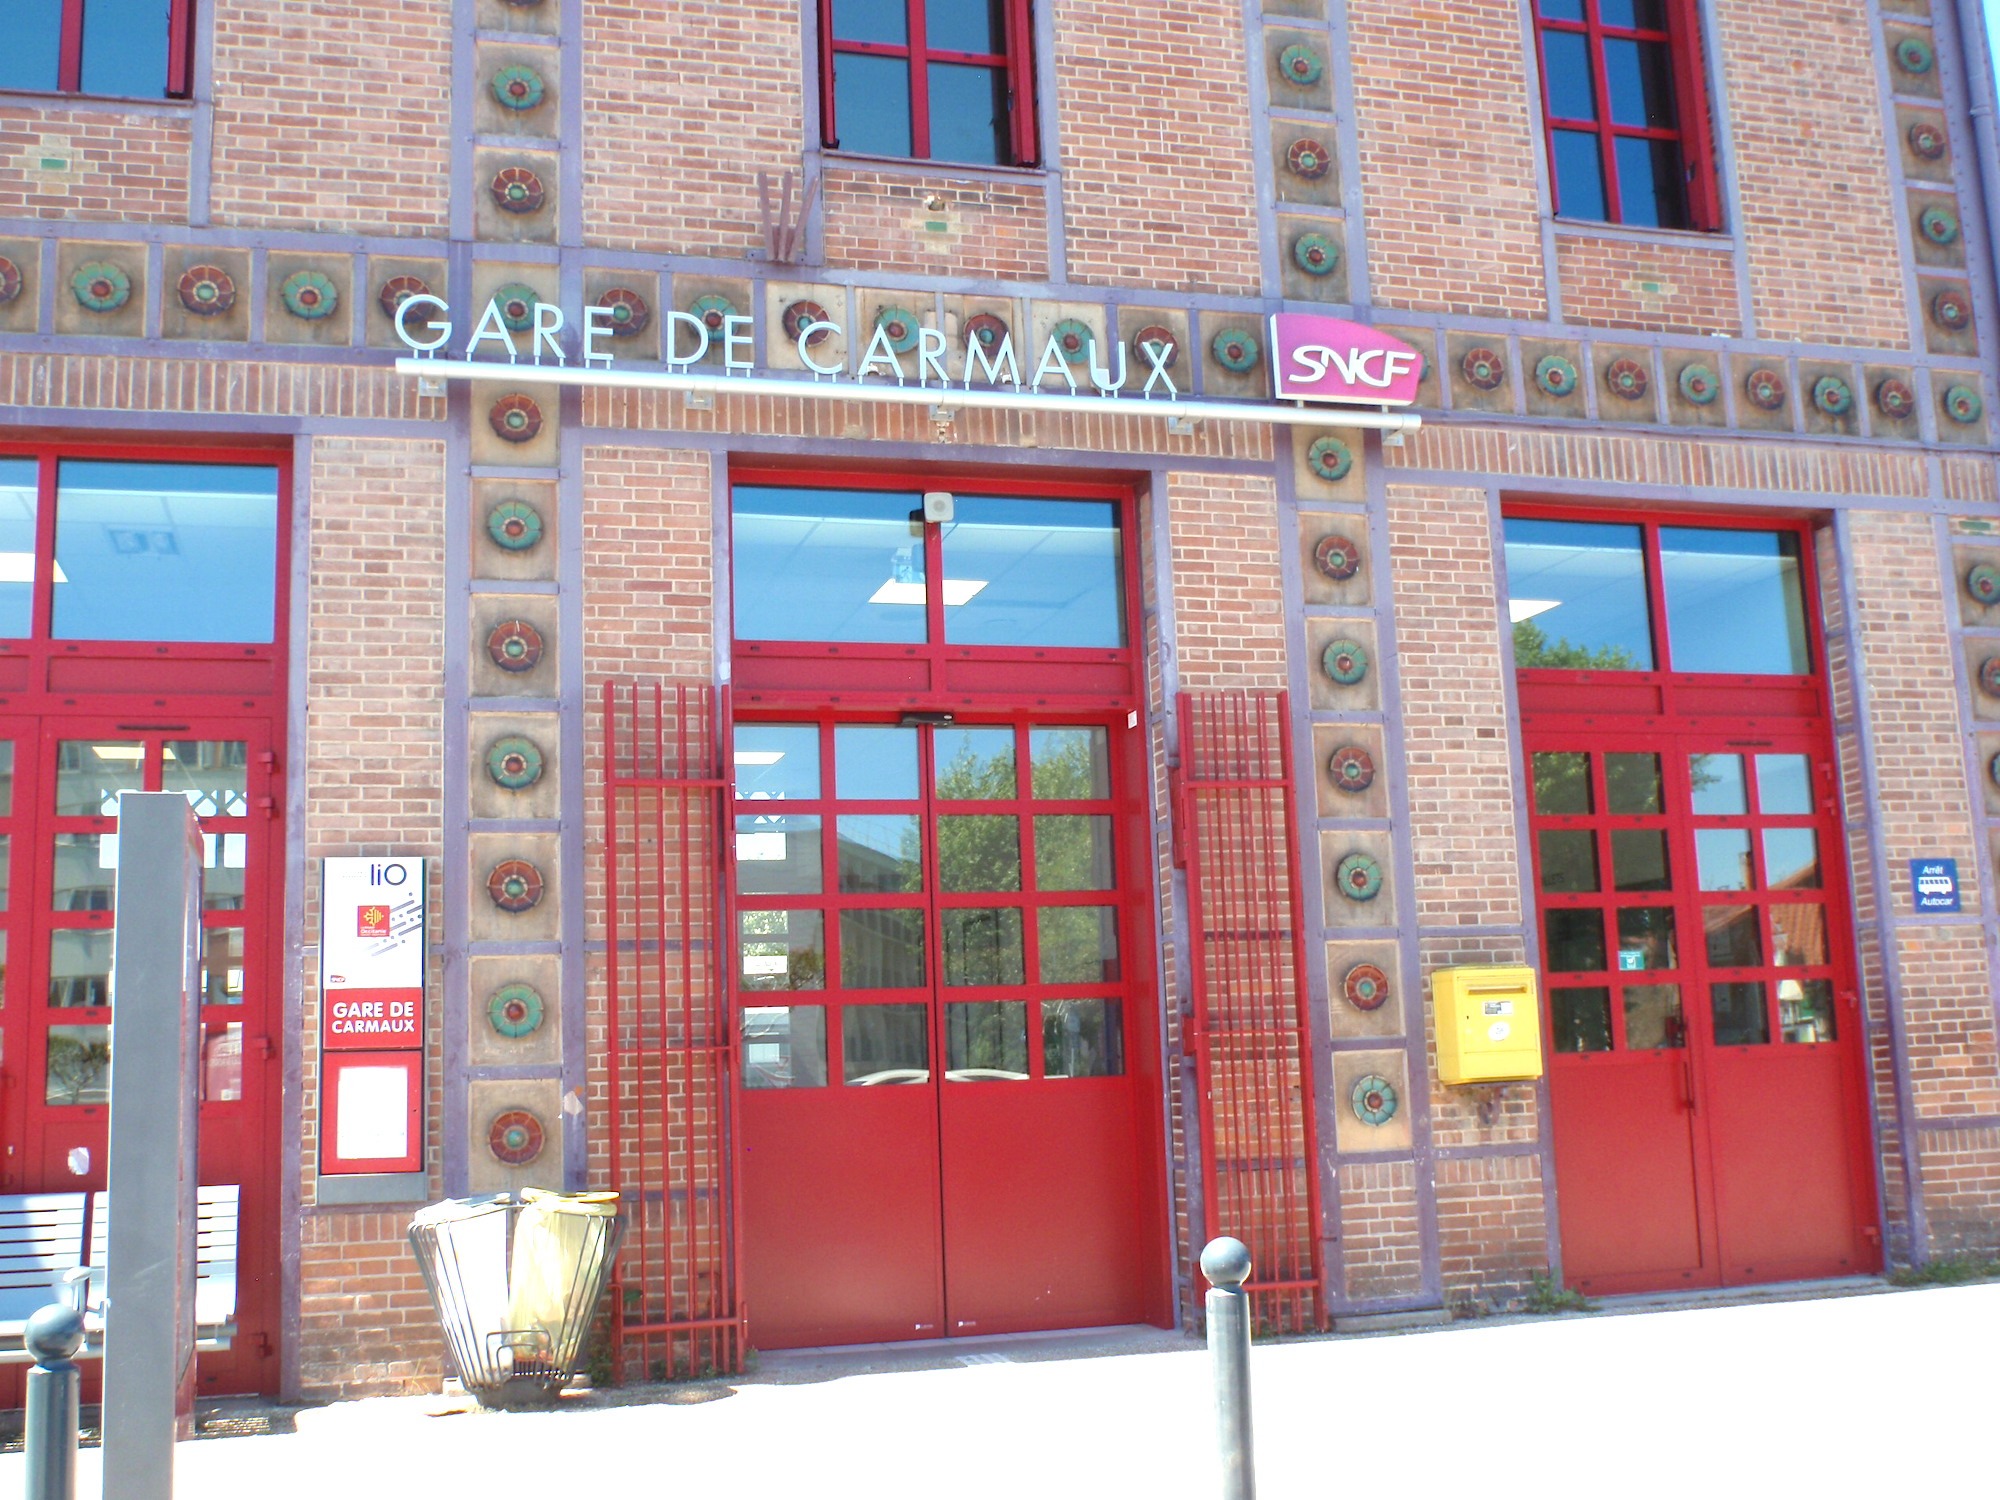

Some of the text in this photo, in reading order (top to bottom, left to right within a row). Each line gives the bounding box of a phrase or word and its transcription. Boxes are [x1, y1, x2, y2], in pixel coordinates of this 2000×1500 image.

[394, 294, 1177, 394] GARE DE CARMAUX
[1288, 345, 1416, 387] SNCF
[1921, 897, 1953, 906] Autocar
[332, 1001, 414, 1018] GARE DE
[331, 1019, 415, 1034] CARMAUX
